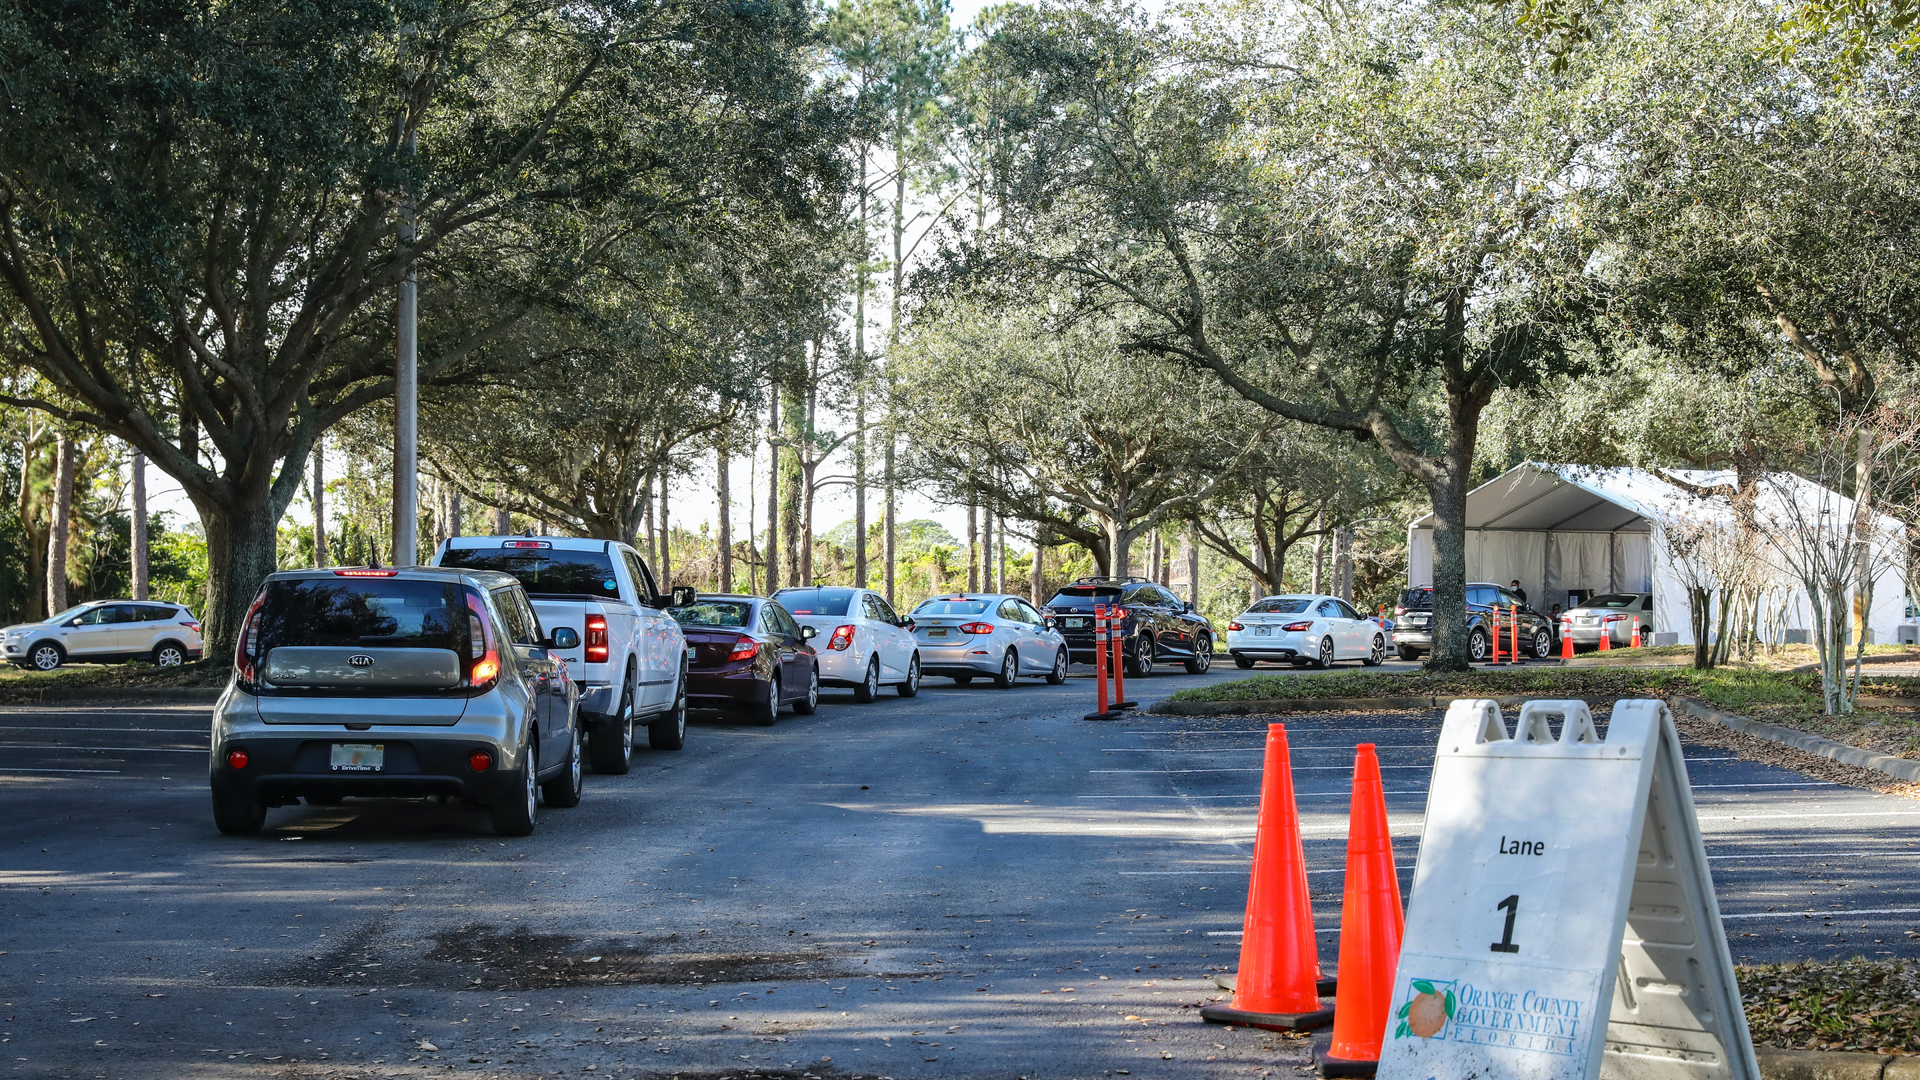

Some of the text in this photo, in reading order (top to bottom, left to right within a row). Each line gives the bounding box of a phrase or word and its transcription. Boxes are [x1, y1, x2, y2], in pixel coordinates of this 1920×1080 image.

[351, 657, 370, 665] KIA
[1499, 835, 1545, 856] Lane
[1490, 894, 1519, 954] 1
[1460, 983, 1583, 1018] ORANGE COUNTY
[1456, 1007, 1580, 1037] GOVERNMENT
[1454, 1027, 1573, 1054] FLORIDA
